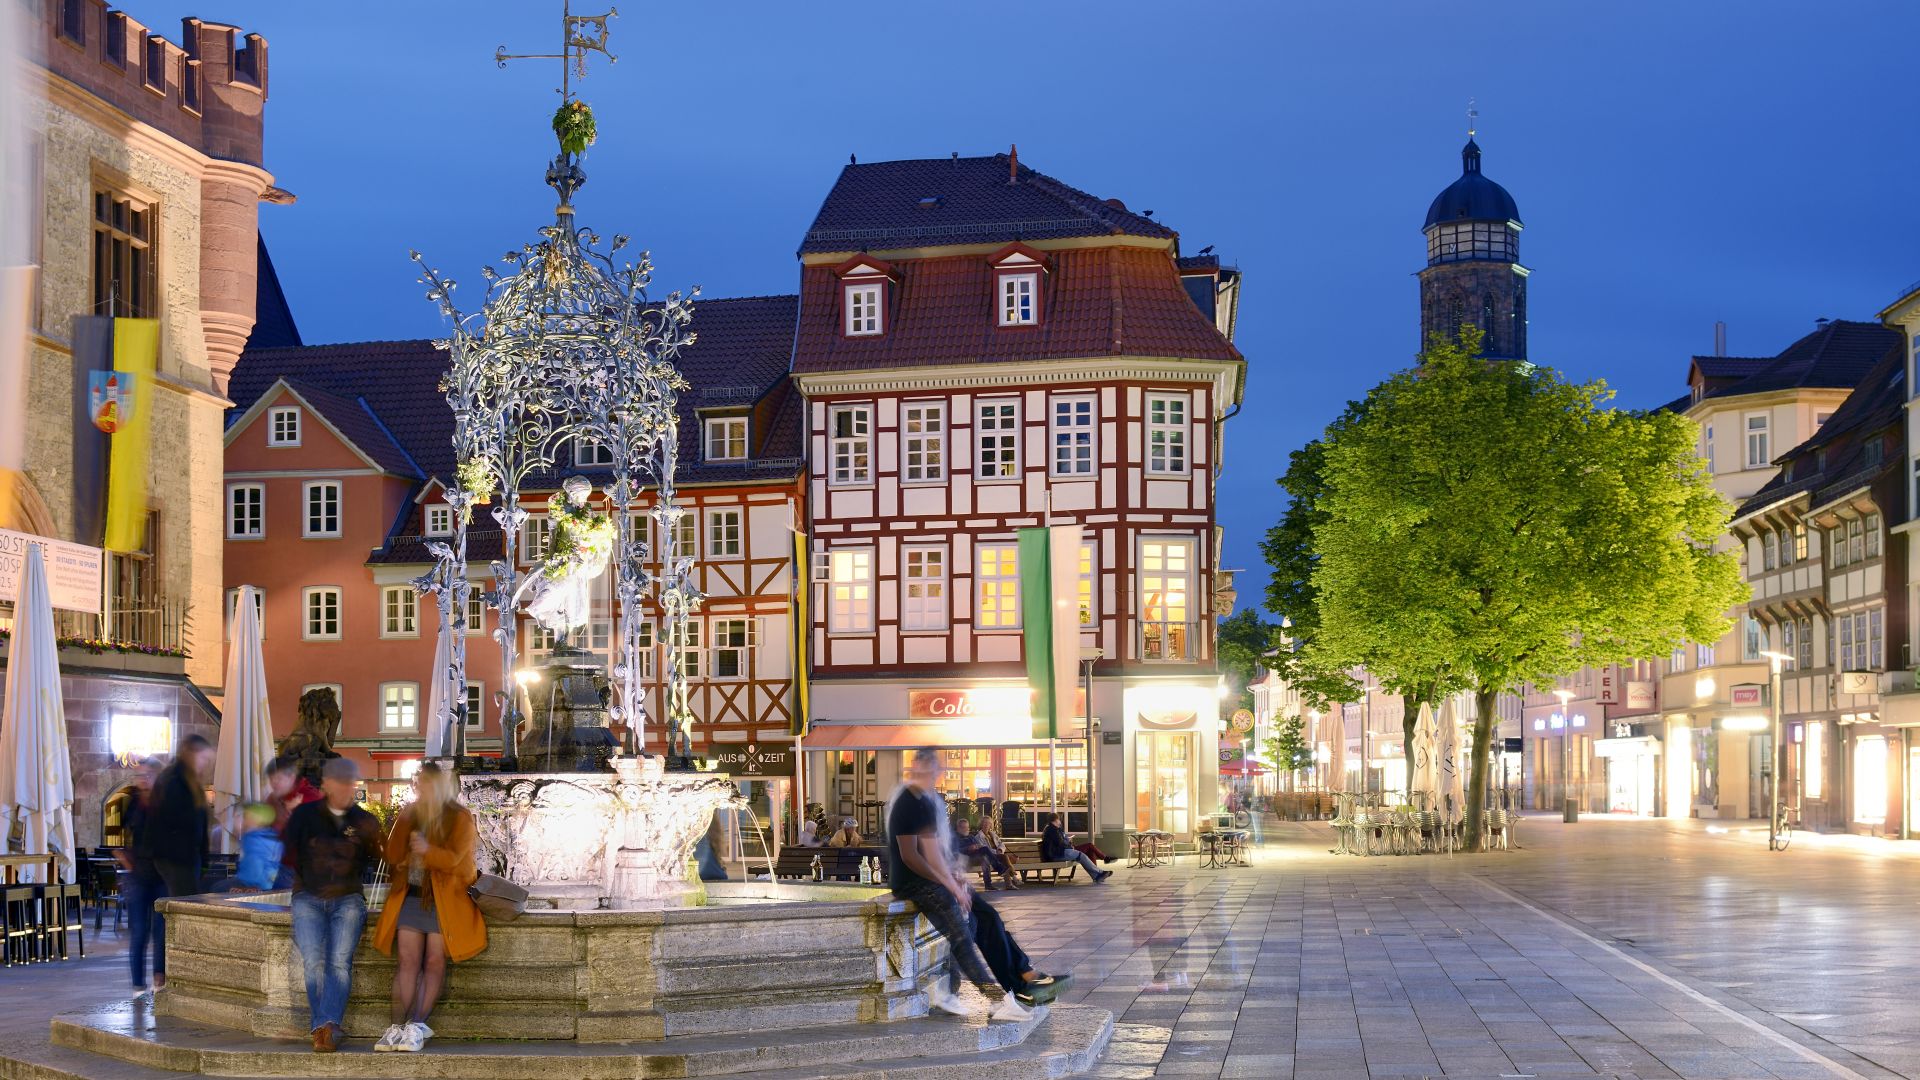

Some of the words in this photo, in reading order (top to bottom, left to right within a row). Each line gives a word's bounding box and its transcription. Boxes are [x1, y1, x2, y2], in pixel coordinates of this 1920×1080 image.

[13, 537, 49, 558] STTE
[718, 753, 737, 763] AUS
[764, 752, 786, 763] ZEIT
